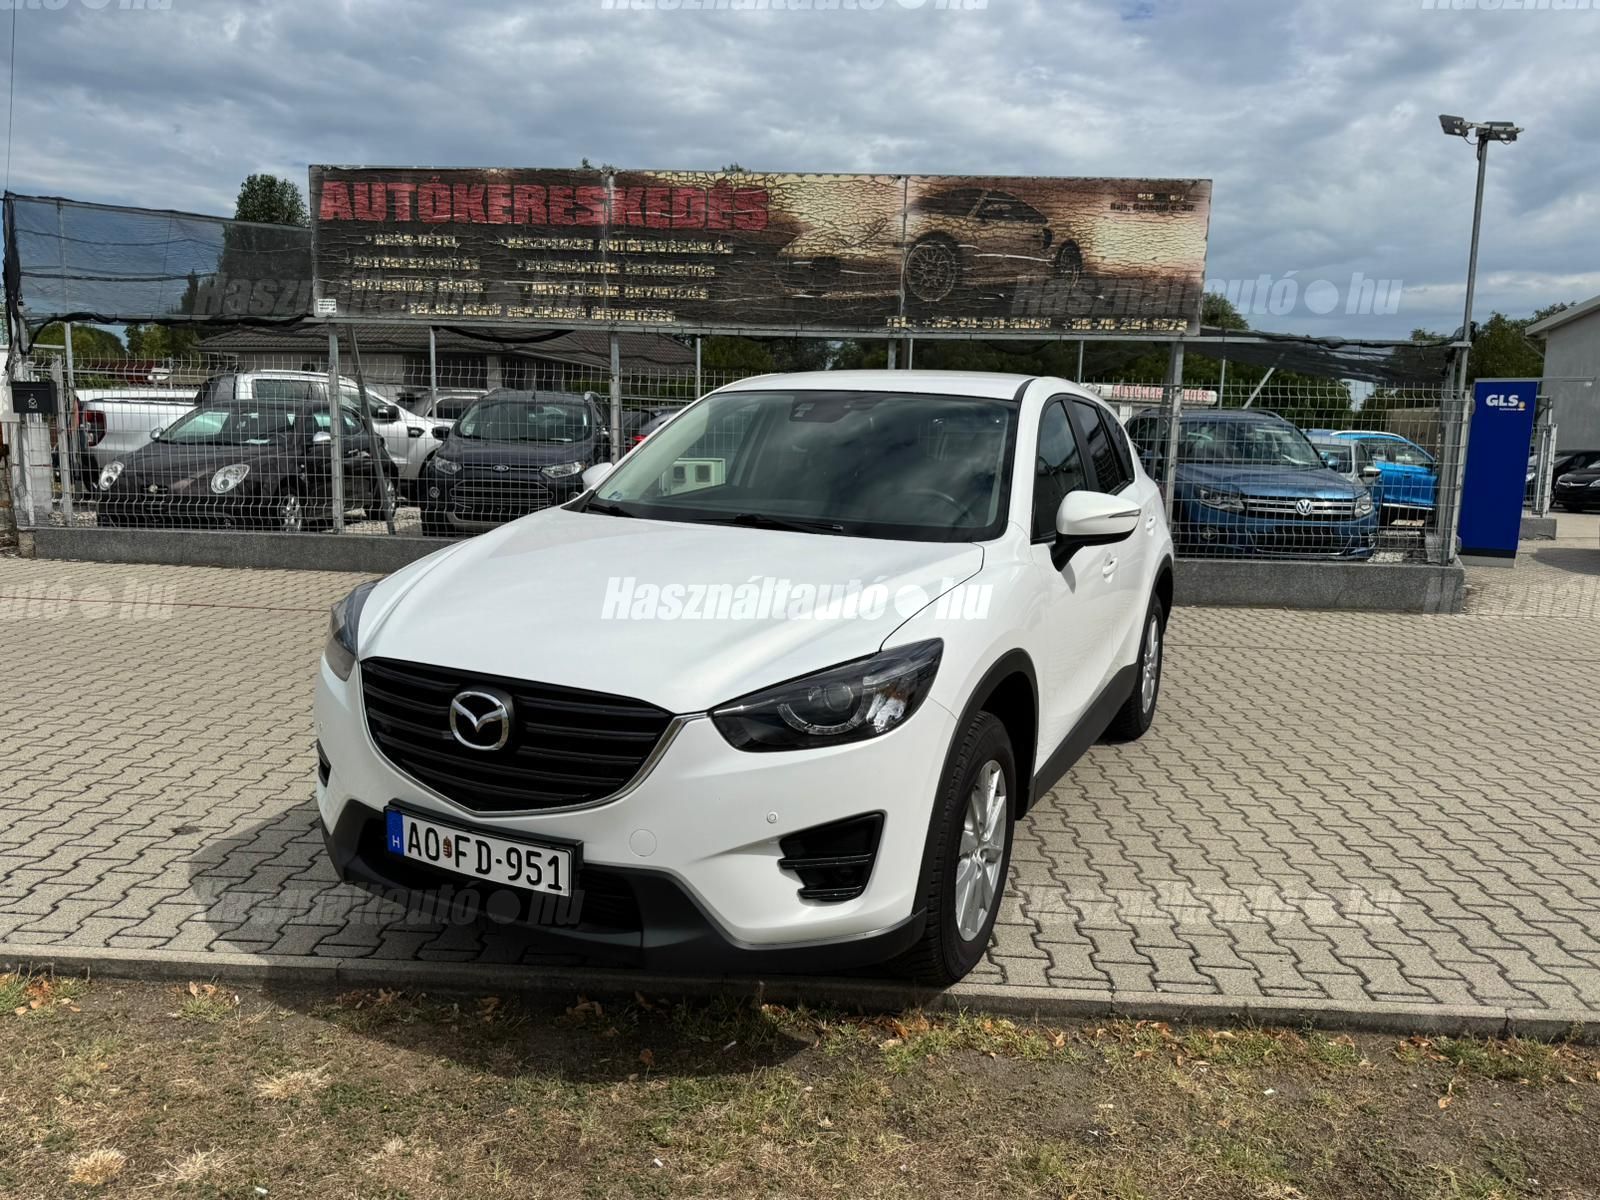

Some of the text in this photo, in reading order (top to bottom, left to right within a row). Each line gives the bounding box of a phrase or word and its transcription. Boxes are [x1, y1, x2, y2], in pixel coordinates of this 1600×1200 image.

[318, 176, 768, 230] AUTÓKERESKEDÉS
[392, 835, 401, 848] H
[454, 834, 562, 891] FD-951
